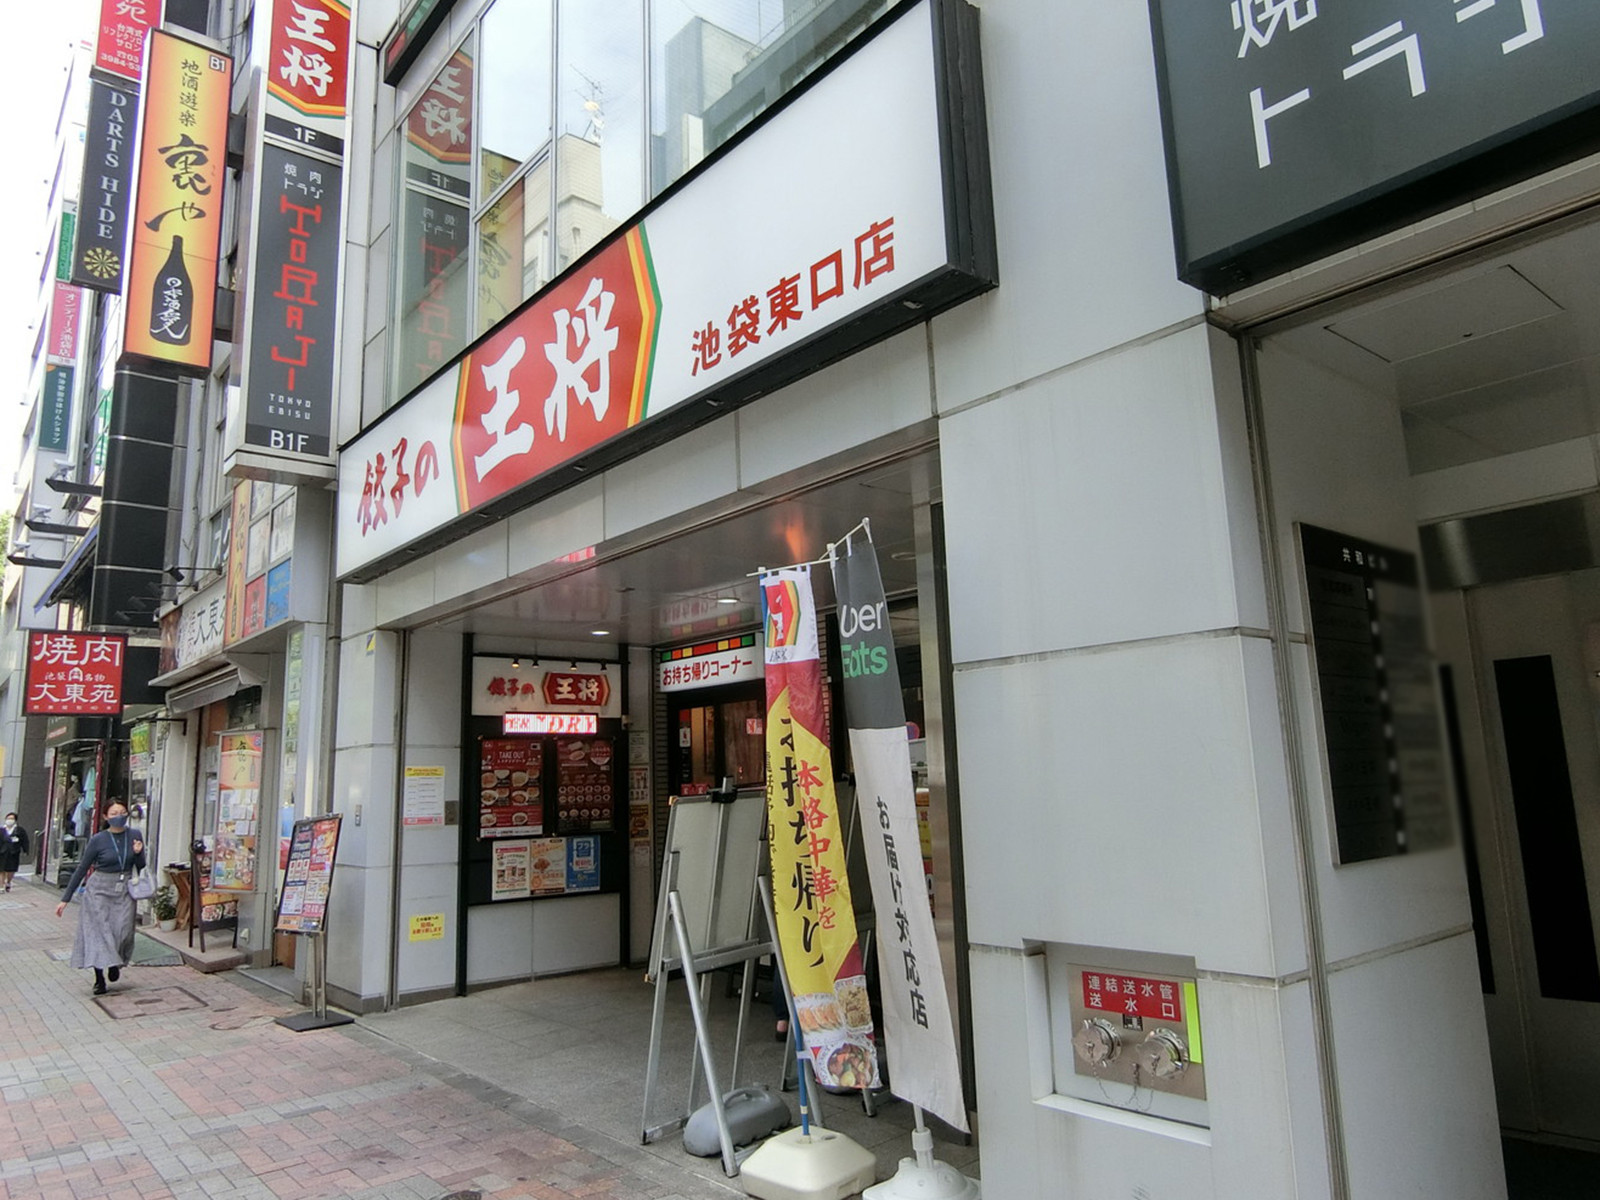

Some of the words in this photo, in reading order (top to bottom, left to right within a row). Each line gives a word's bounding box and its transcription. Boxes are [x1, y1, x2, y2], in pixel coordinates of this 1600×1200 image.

[280, 0, 336, 98] 王将
[209, 55, 226, 73] B1
[105, 91, 128, 168] DARTS
[295, 126, 317, 144] 1F
[284, 163, 321, 184] 焼肉
[284, 178, 323, 199] トラジ
[98, 176, 120, 239] HIDE
[271, 194, 322, 391] TORAJI
[691, 216, 895, 377] 池袋東口店
[474, 276, 619, 482] 王将
[269, 406, 311, 420] EBISU
[270, 393, 311, 408] TOKYO
[270, 429, 309, 452] B1F
[357, 437, 439, 537] 餃子の
[33, 633, 121, 667] 焼肉
[841, 641, 889, 679] Eats
[663, 655, 752, 687] お持ち帰りコーナー
[30, 683, 118, 704] 大東苑
[487, 676, 535, 698] 餃子の
[555, 677, 600, 702] 王将
[796, 760, 838, 930] 本格中華を
[1088, 975, 1173, 1001] 連結送水管
[1090, 992, 1175, 1018] 送水口
